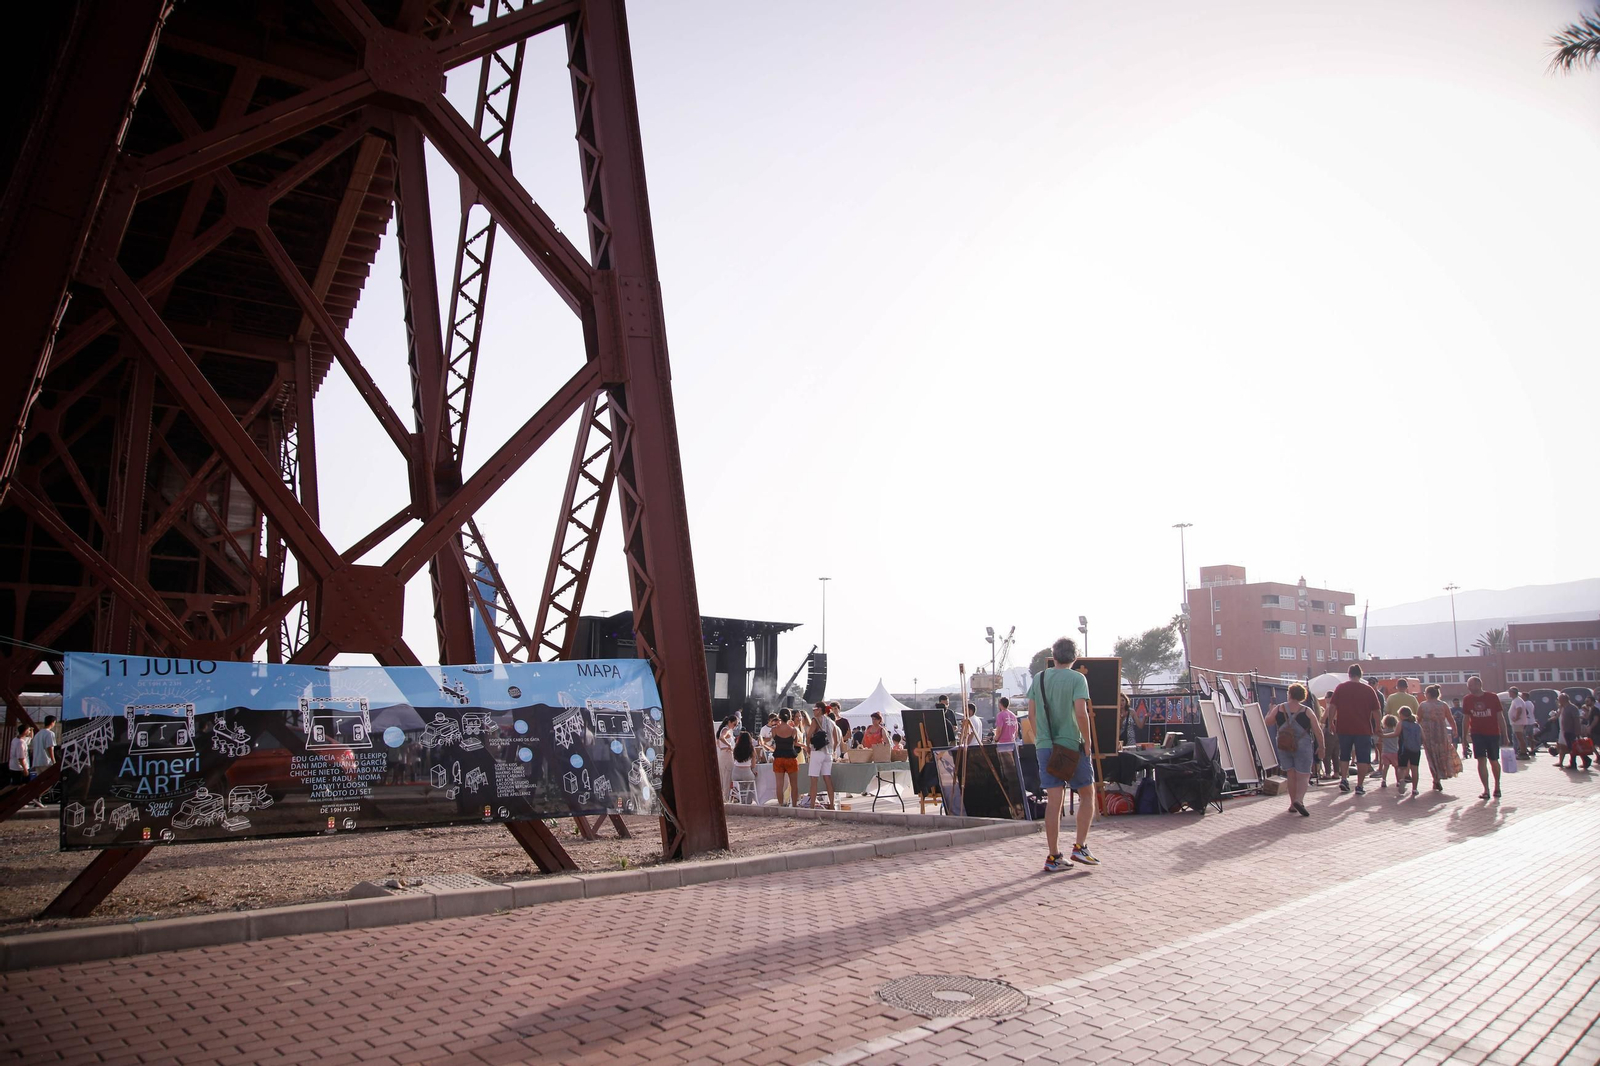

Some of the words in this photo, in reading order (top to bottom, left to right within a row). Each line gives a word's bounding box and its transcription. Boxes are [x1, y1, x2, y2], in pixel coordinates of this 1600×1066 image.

[102, 659, 127, 676] 11
[141, 659, 217, 676] JULIO
[577, 664, 621, 679] MAPA
[118, 753, 200, 778] Almeri
[309, 754, 335, 762] GARCÍA
[136, 774, 185, 794] ART
[146, 799, 174, 812] South
[151, 808, 169, 817] Kids
